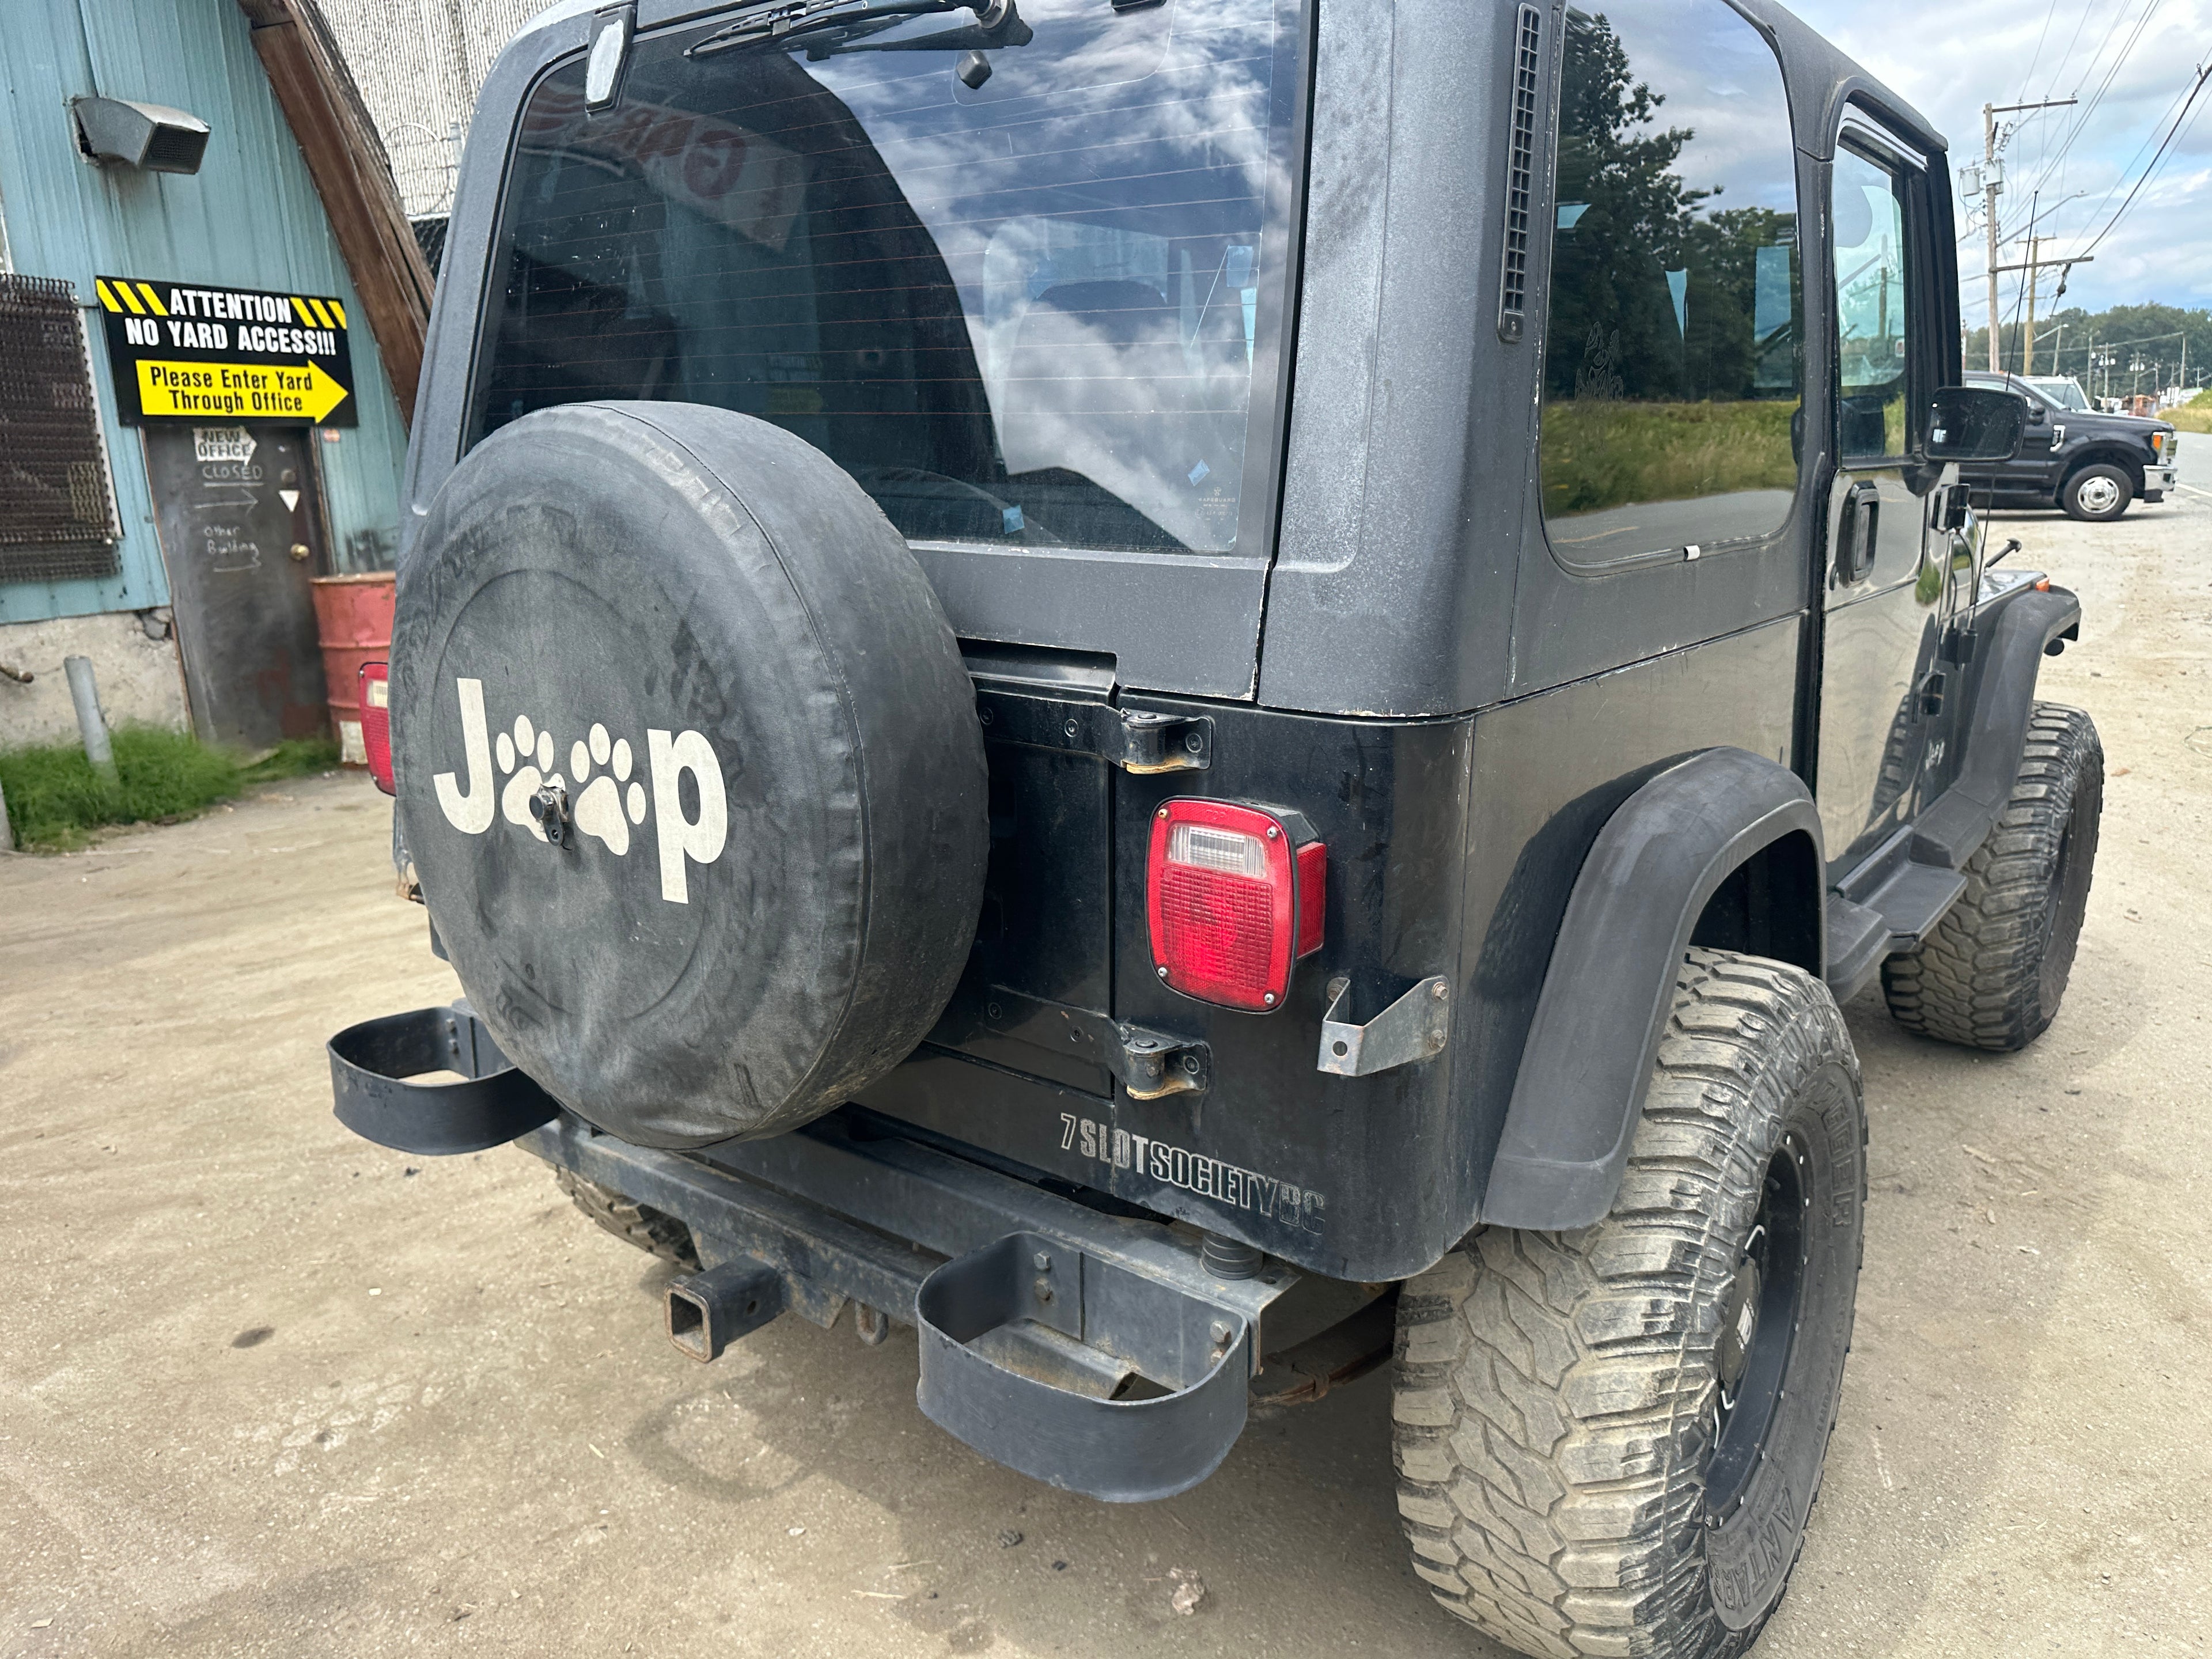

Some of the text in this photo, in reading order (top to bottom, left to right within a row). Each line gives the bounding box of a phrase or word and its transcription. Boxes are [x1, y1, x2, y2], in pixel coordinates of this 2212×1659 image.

[171, 288, 292, 323] ATTENTION
[124, 317, 336, 356] NO YARD ACCESS!!!
[150, 366, 313, 391] Please Enter Yard
[169, 389, 303, 413] Through Office
[201, 430, 240, 443] NEW
[197, 442, 251, 457] OFFICE
[202, 465, 263, 480] CLOSED
